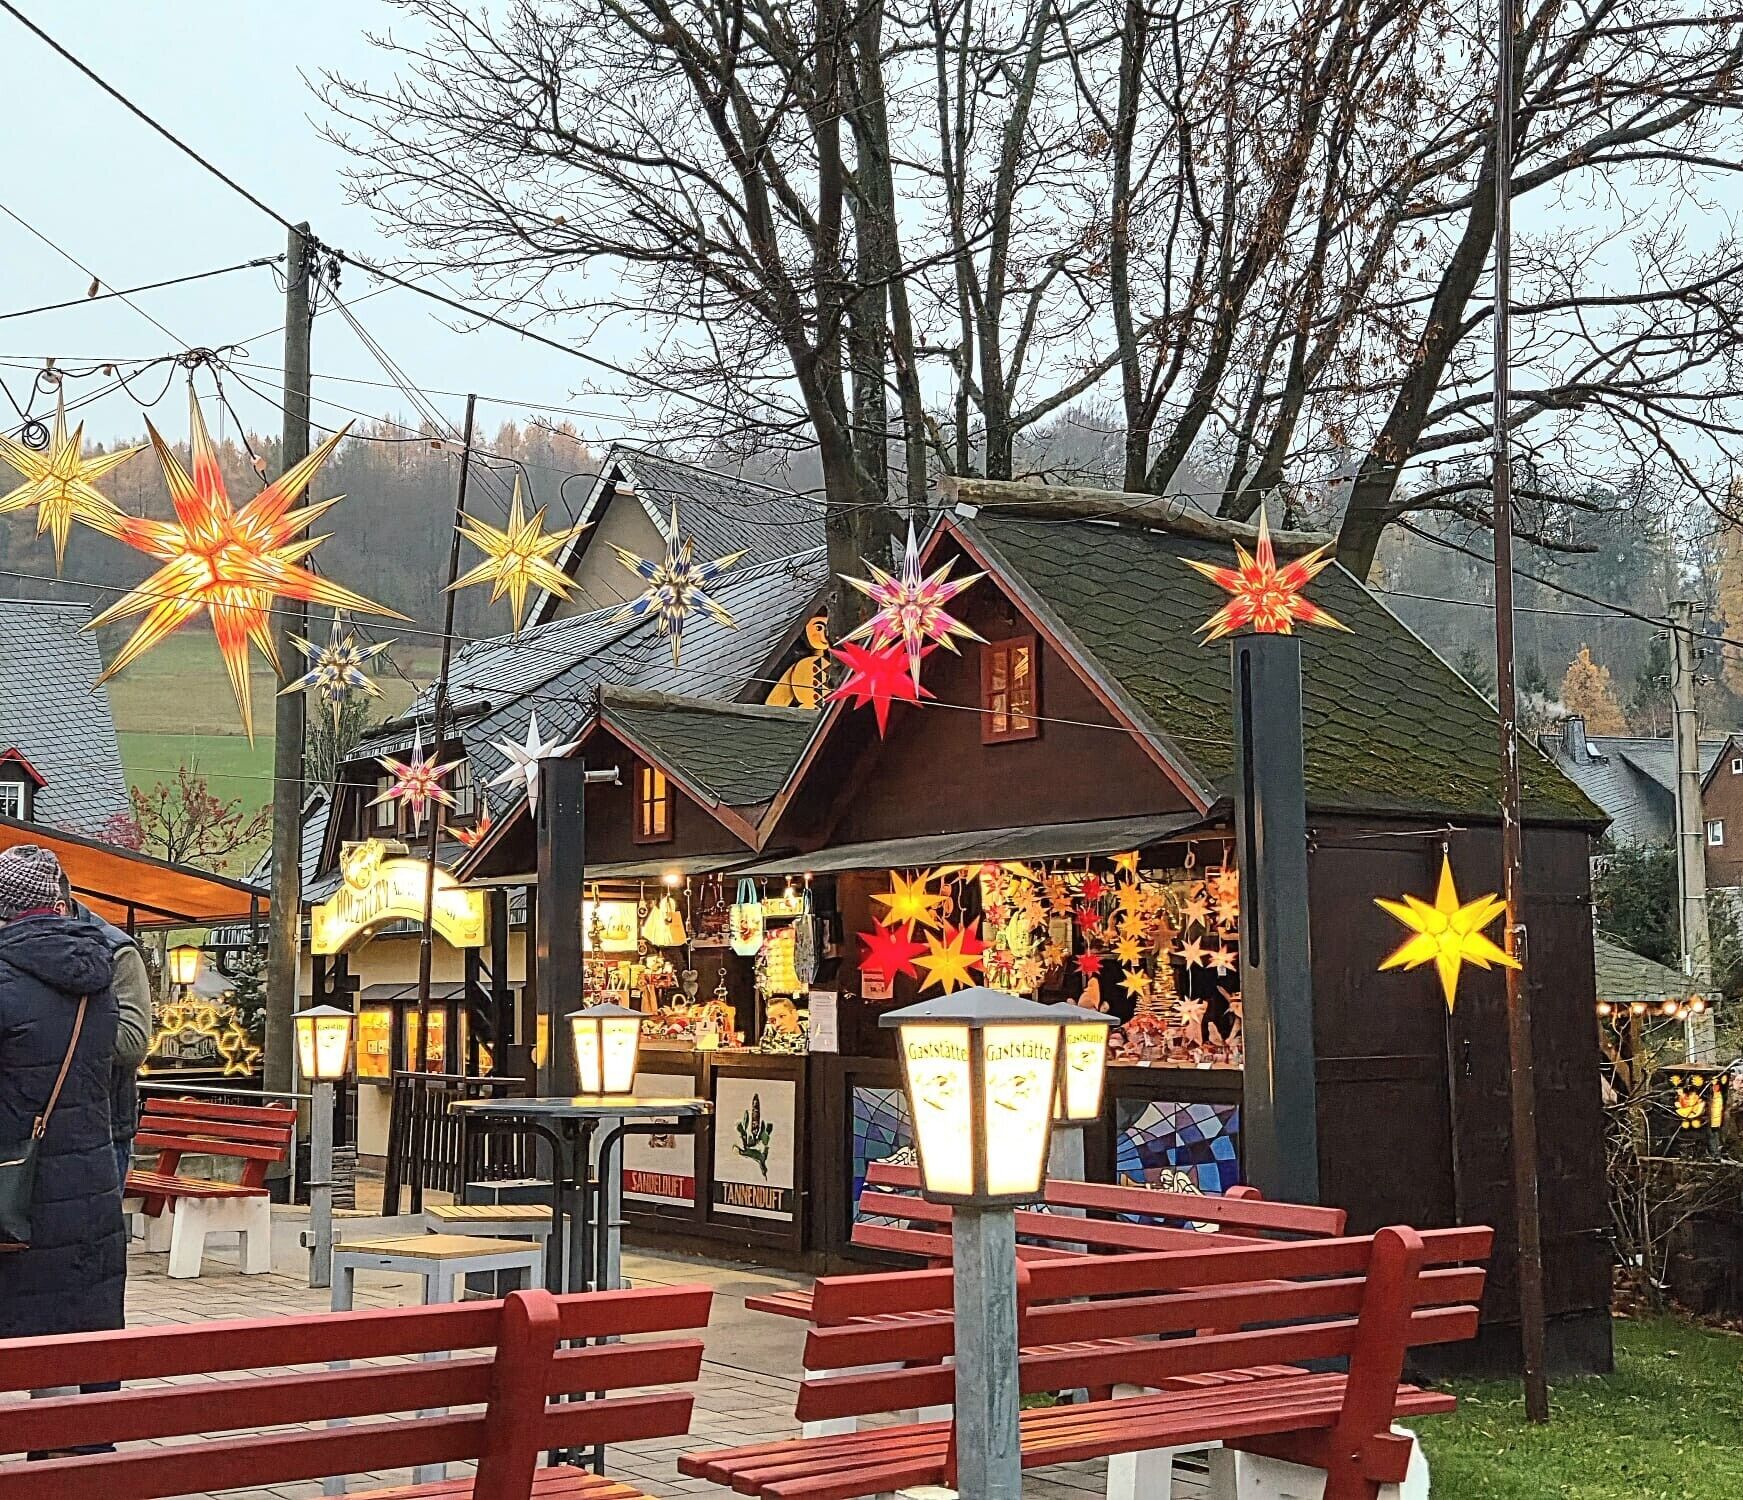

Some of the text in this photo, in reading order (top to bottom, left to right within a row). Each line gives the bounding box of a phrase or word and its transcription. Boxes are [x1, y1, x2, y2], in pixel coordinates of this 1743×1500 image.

[1067, 1033, 1104, 1044] Gaststätte
[909, 1040, 969, 1062] Gaststätte
[986, 1040, 1051, 1062] Gaststätte
[631, 1172, 685, 1197] SANDELDUFT
[722, 1183, 785, 1210] TANNENDUFT
